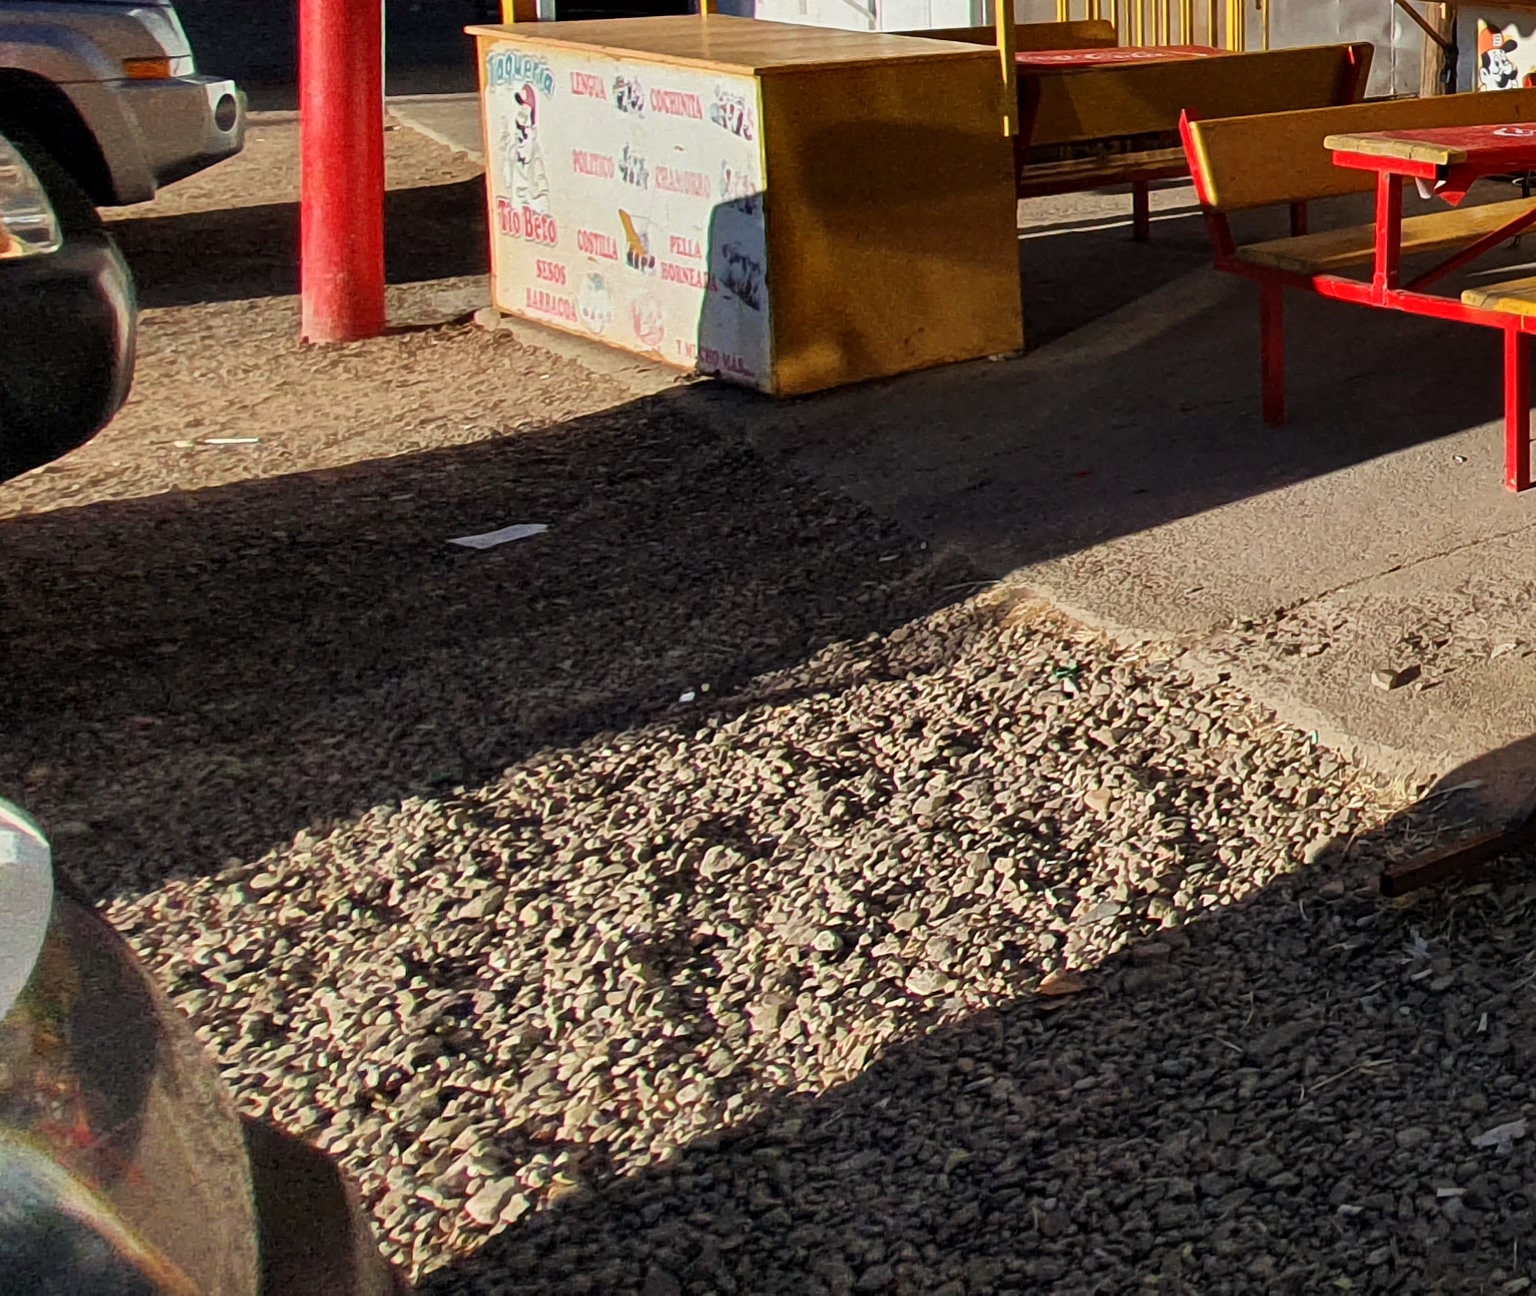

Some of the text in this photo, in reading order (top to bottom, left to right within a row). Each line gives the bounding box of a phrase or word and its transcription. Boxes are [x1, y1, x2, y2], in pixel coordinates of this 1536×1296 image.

[496, 198, 558, 247] Tio Beto
[577, 229, 619, 261] COSTILLA
[669, 234, 704, 260] PELLA
[535, 258, 567, 286] SESOS
